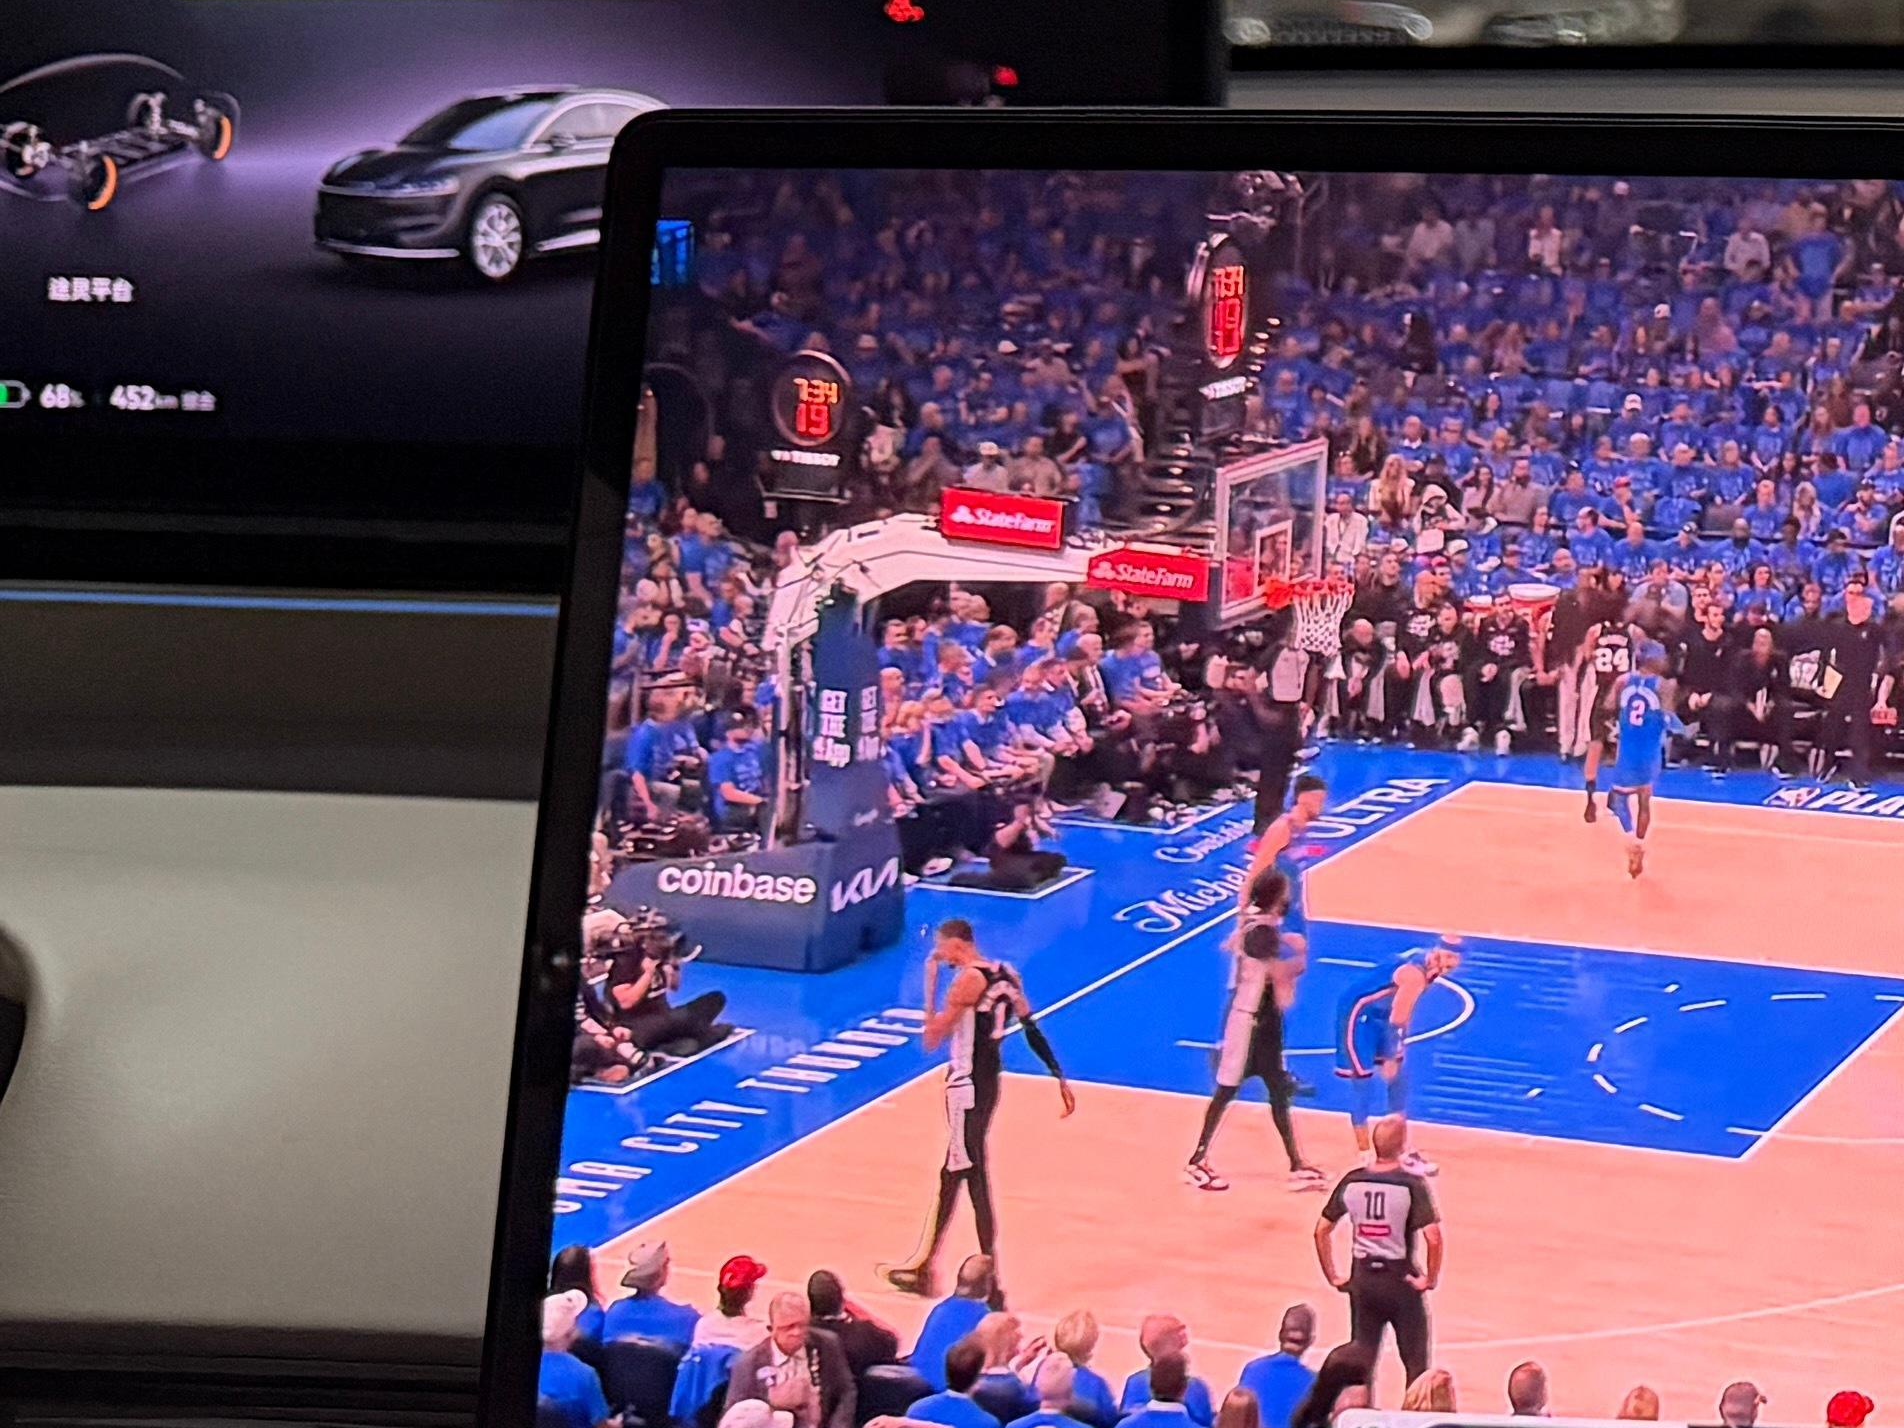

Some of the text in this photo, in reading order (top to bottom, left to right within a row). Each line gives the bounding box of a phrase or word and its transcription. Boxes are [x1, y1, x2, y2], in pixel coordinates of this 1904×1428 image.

[796, 403, 830, 435] 19
[1594, 648, 1630, 673] 24
[1629, 698, 1646, 727] 2
[657, 861, 818, 904] coinbase
[620, 1099, 769, 1154] CITY
[1364, 1190, 1386, 1220] 10
